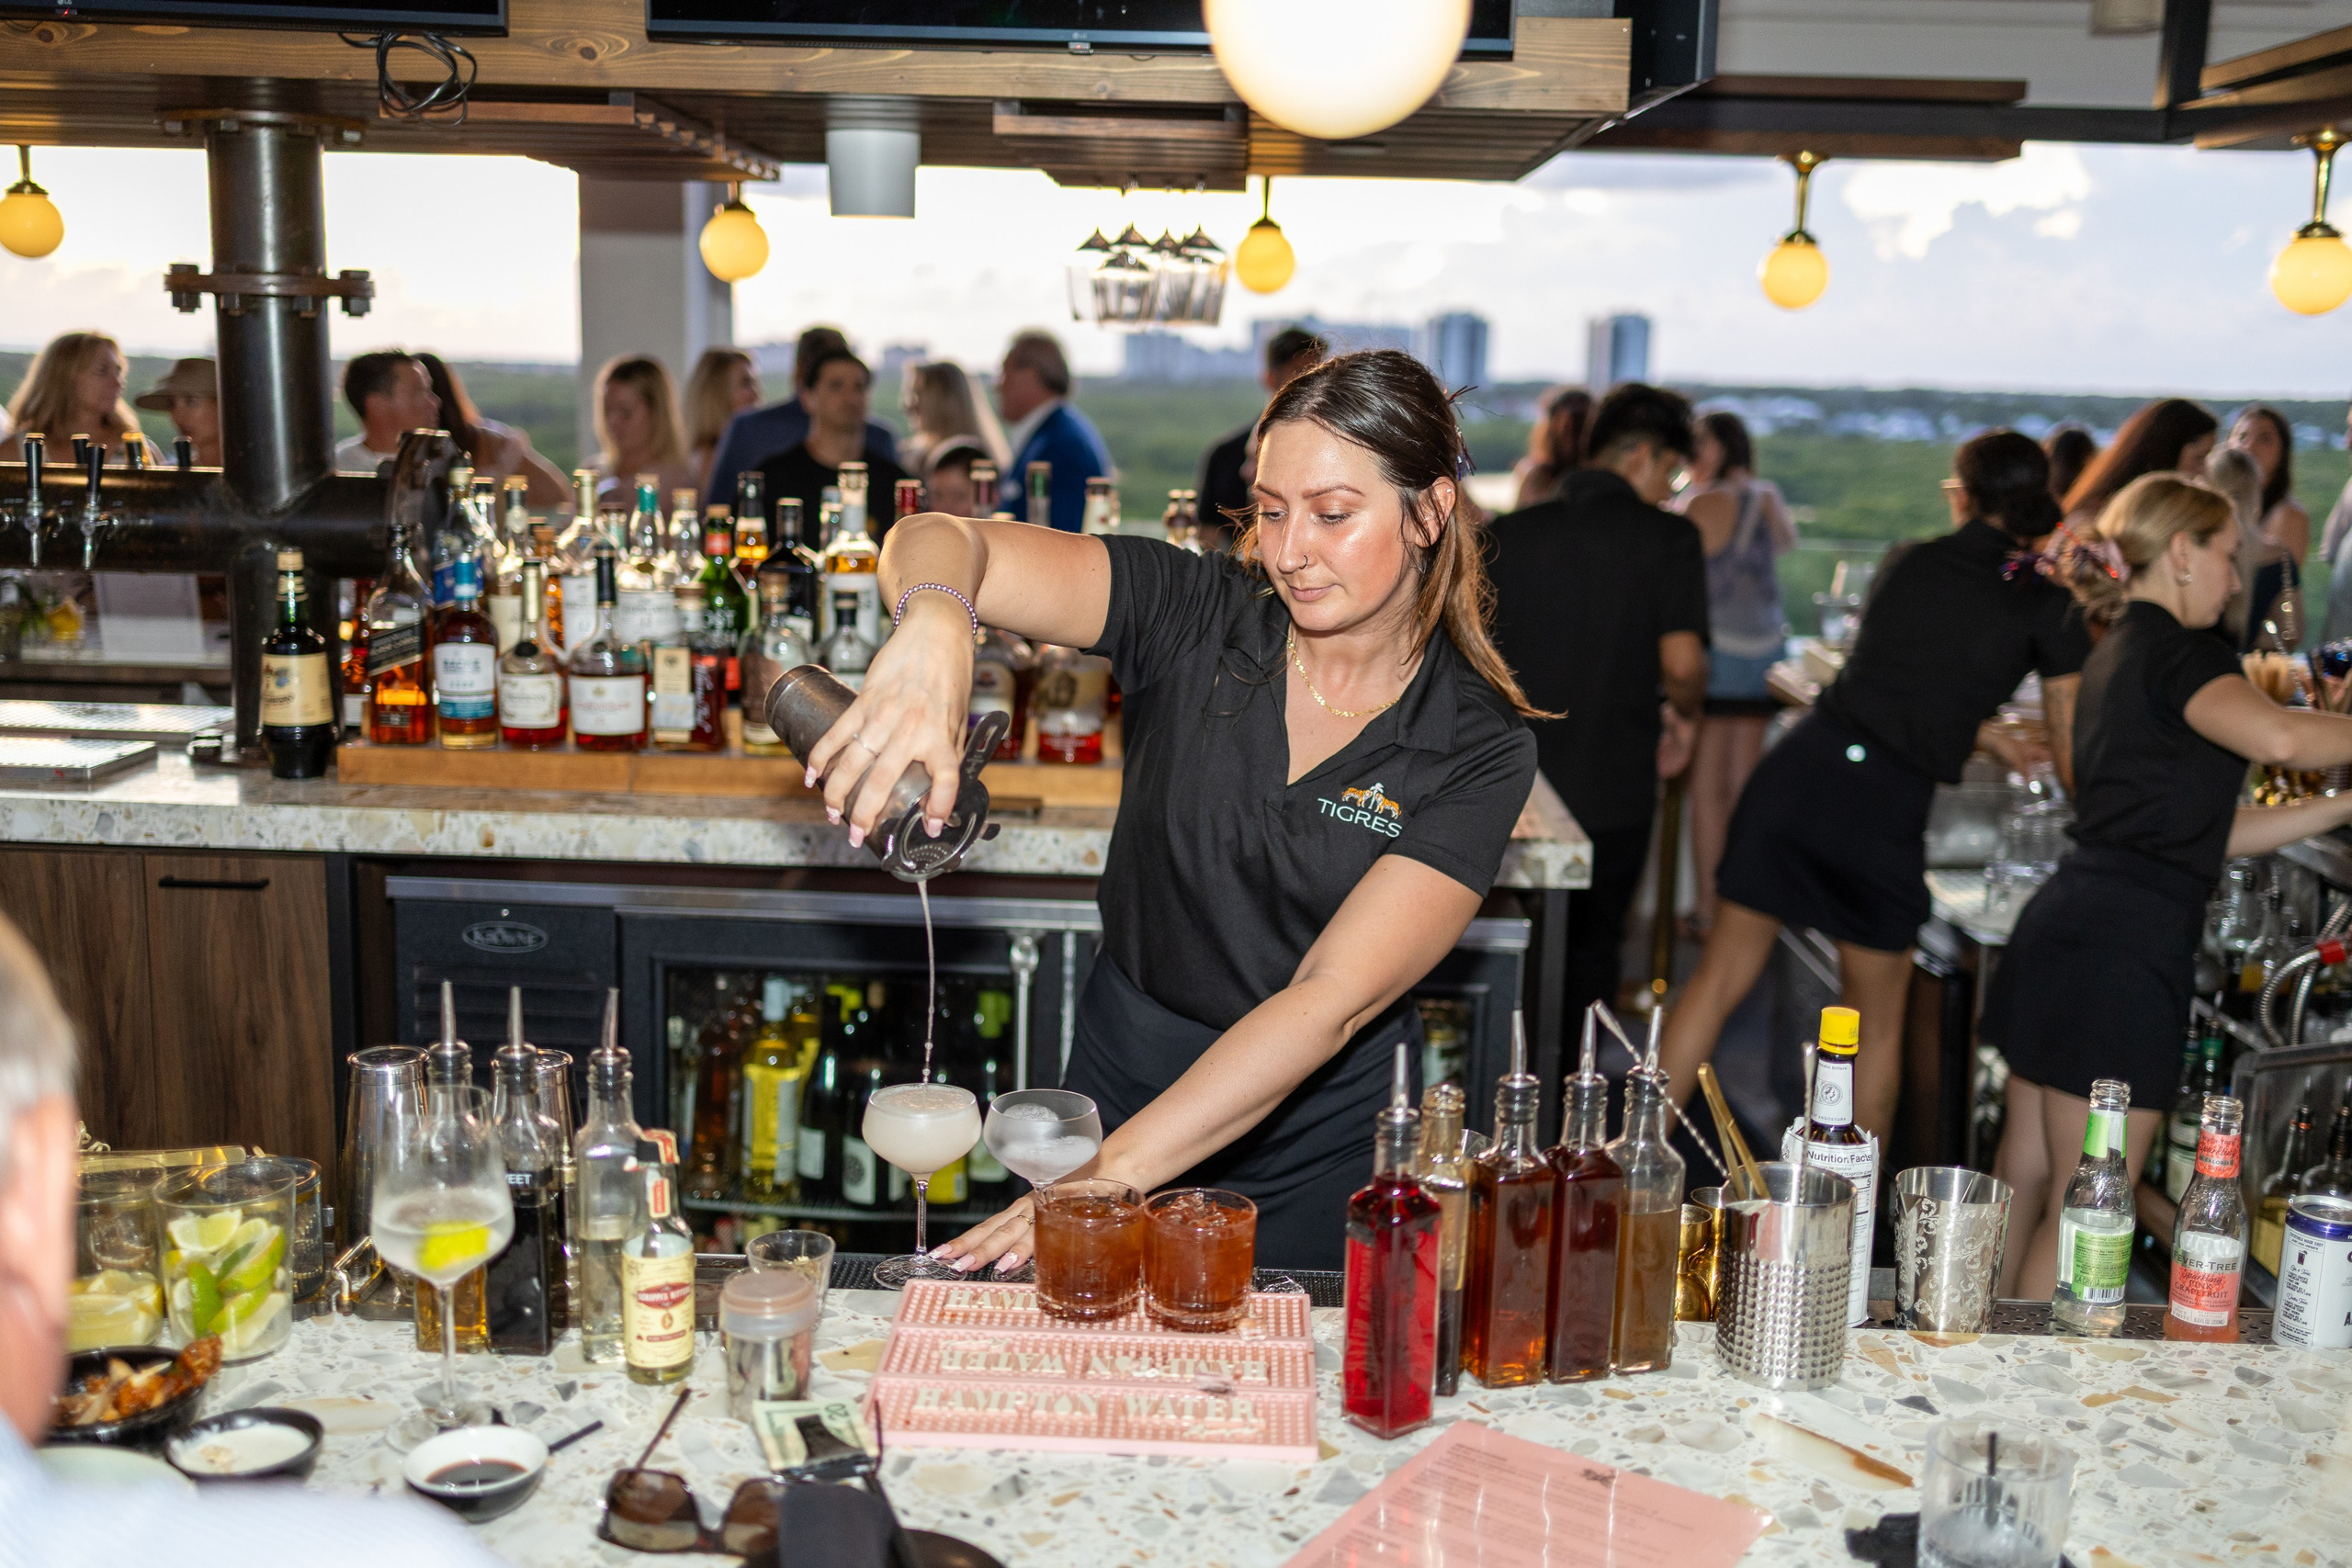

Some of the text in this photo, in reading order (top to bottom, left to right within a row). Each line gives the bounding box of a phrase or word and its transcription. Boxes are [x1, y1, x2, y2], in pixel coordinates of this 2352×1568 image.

[1317, 797, 1402, 838] TIGRES
[1807, 1150, 1872, 1163] Nutrition Facts
[2205, 1157, 2233, 1166] CALORIES
[1866, 1178, 1871, 1187] 5
[2174, 1251, 2237, 1271] FEVER-TREE
[2174, 1281, 2229, 1299] GRAPEFRUIT
[2188, 1280, 2212, 1291] PINK
[941, 1350, 1066, 1374] WATER
[912, 1387, 1262, 1423] HAMPTON WATER
